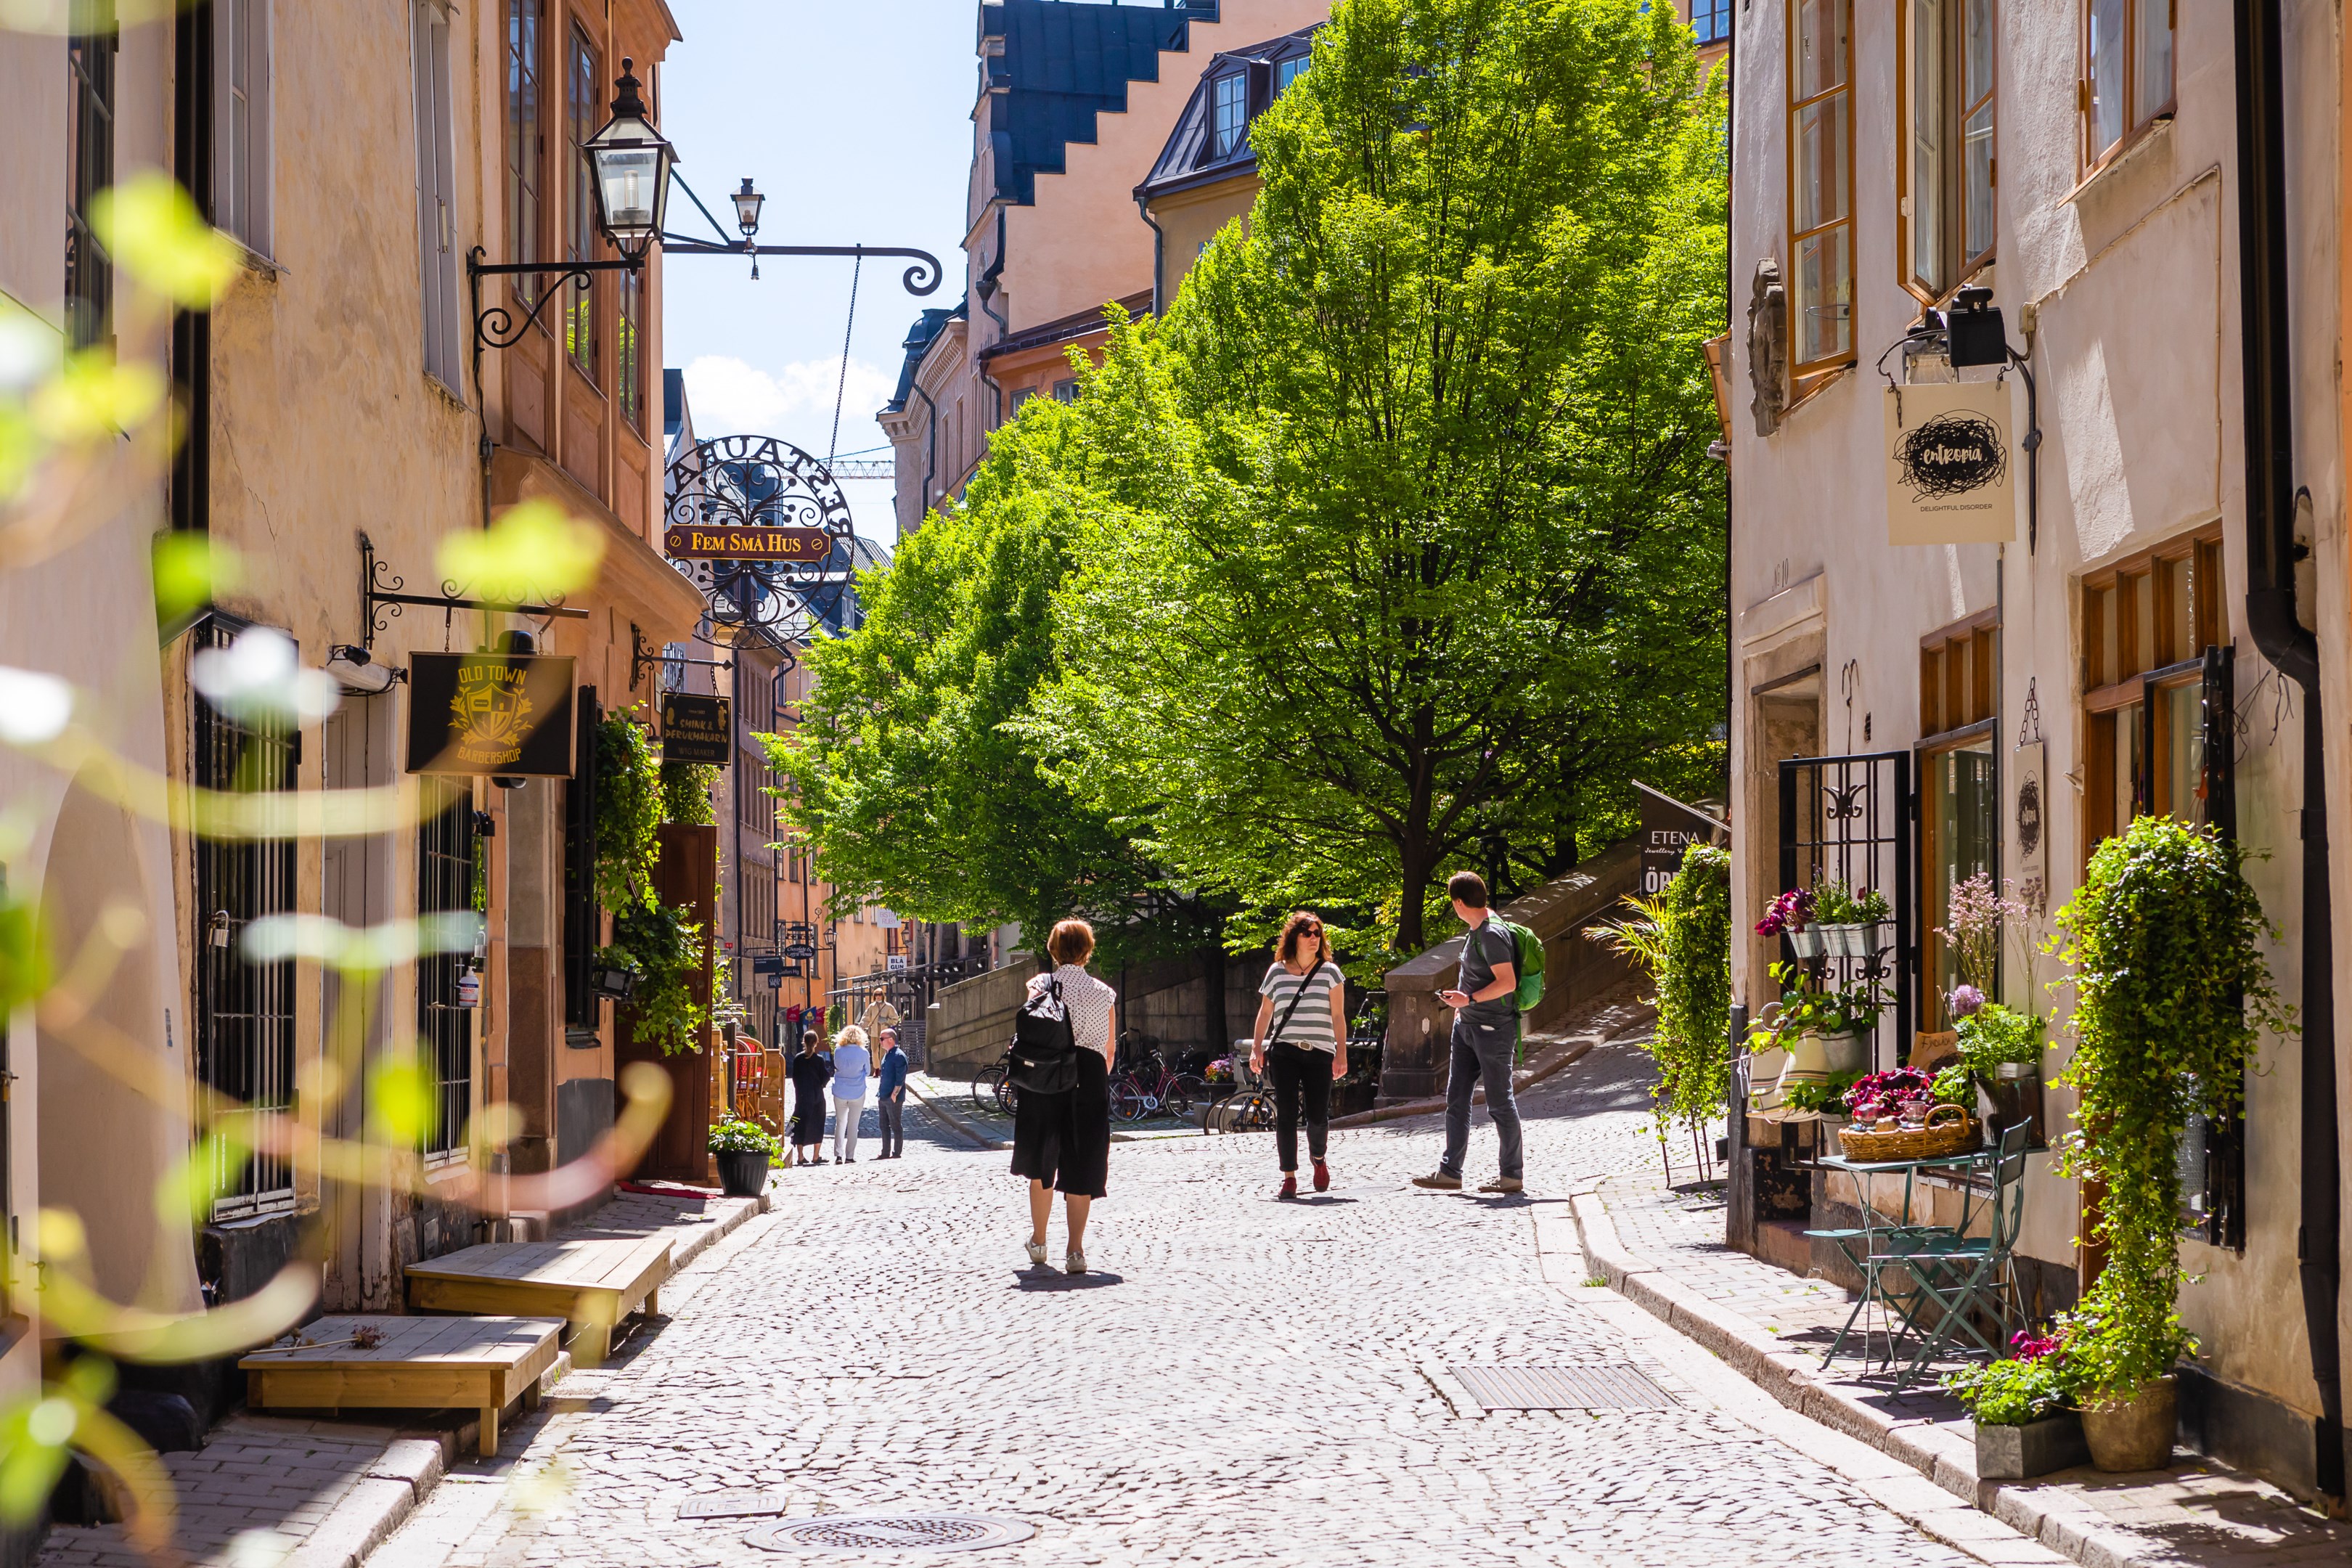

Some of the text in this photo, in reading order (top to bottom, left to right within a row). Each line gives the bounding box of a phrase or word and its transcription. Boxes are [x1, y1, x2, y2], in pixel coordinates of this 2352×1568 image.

[1923, 444, 1983, 465] entropia
[691, 532, 725, 551] FEM
[767, 534, 801, 552] HUS
[458, 665, 527, 685] OLD TOWN
[707, 722, 713, 731] &
[457, 746, 522, 764] BARBERSHOP
[679, 747, 715, 757] WIG MAKER
[1651, 831, 1700, 844] ETENA
